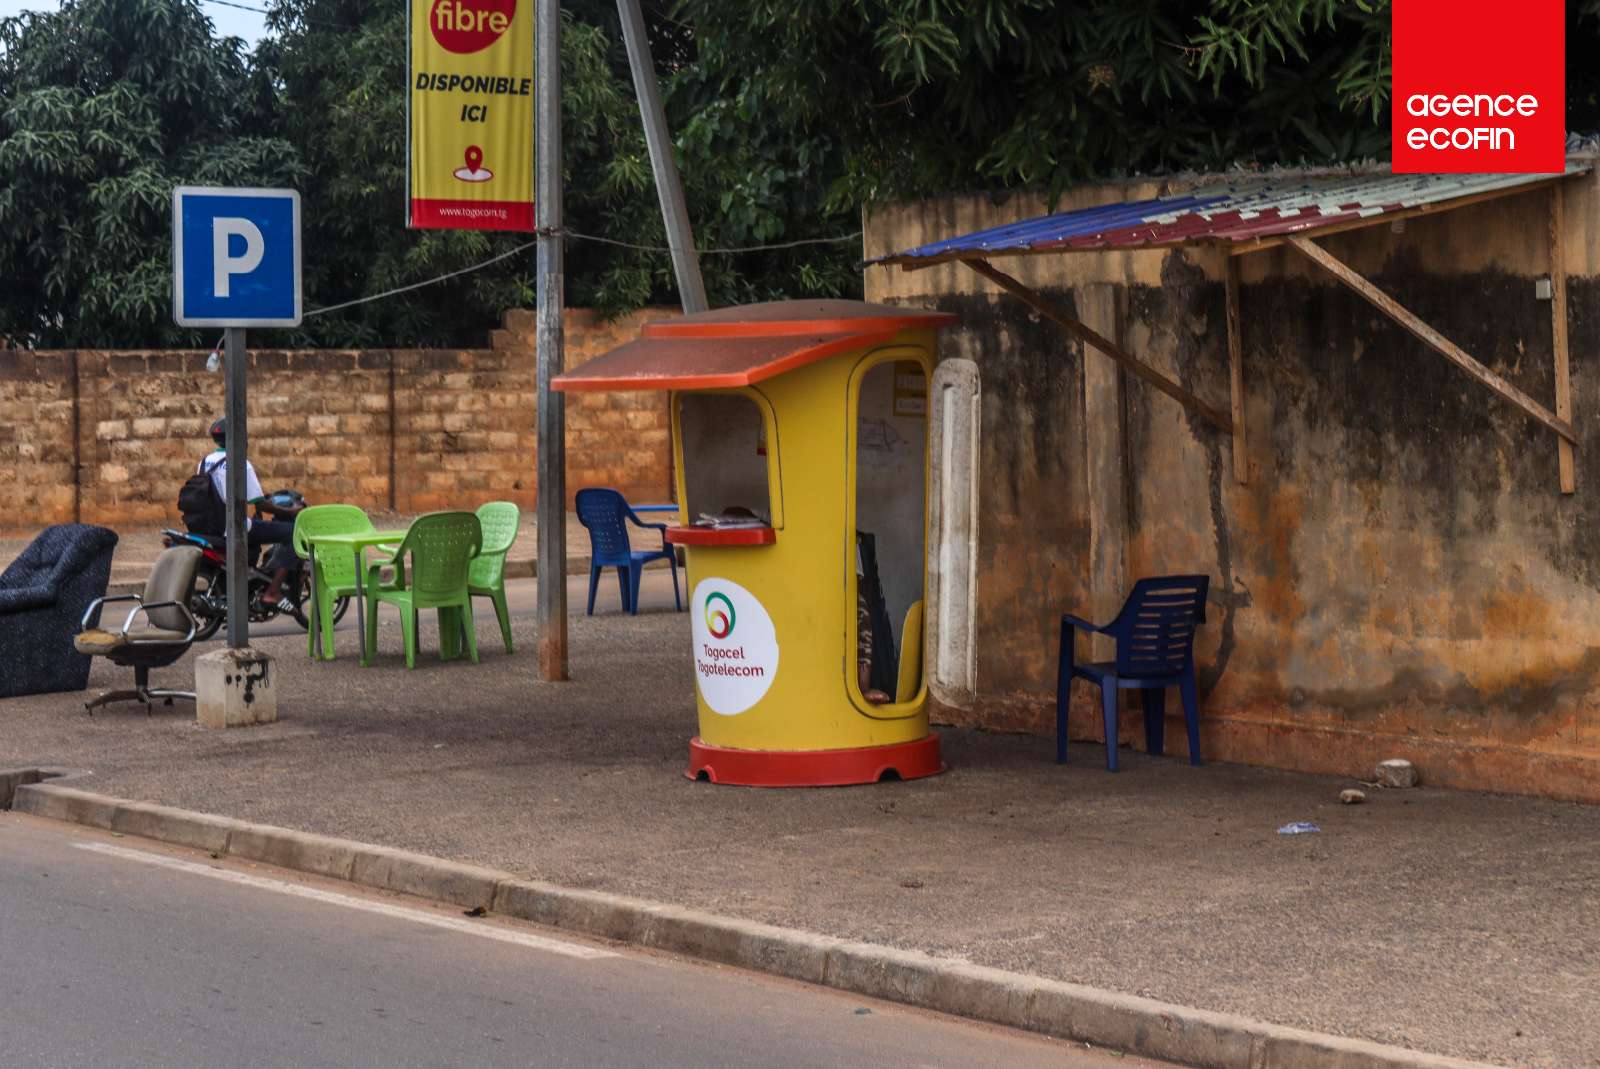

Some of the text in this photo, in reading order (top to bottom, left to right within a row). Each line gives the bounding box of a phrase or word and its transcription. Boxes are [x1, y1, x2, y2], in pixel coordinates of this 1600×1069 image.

[435, 0, 508, 33] fibre
[416, 72, 531, 96] DISPONIBLE
[461, 104, 487, 122] ICI
[439, 207, 508, 220] www.togocom.tg
[213, 216, 265, 298] P
[703, 643, 745, 661] Togocel
[697, 659, 764, 677] Togotelecom
